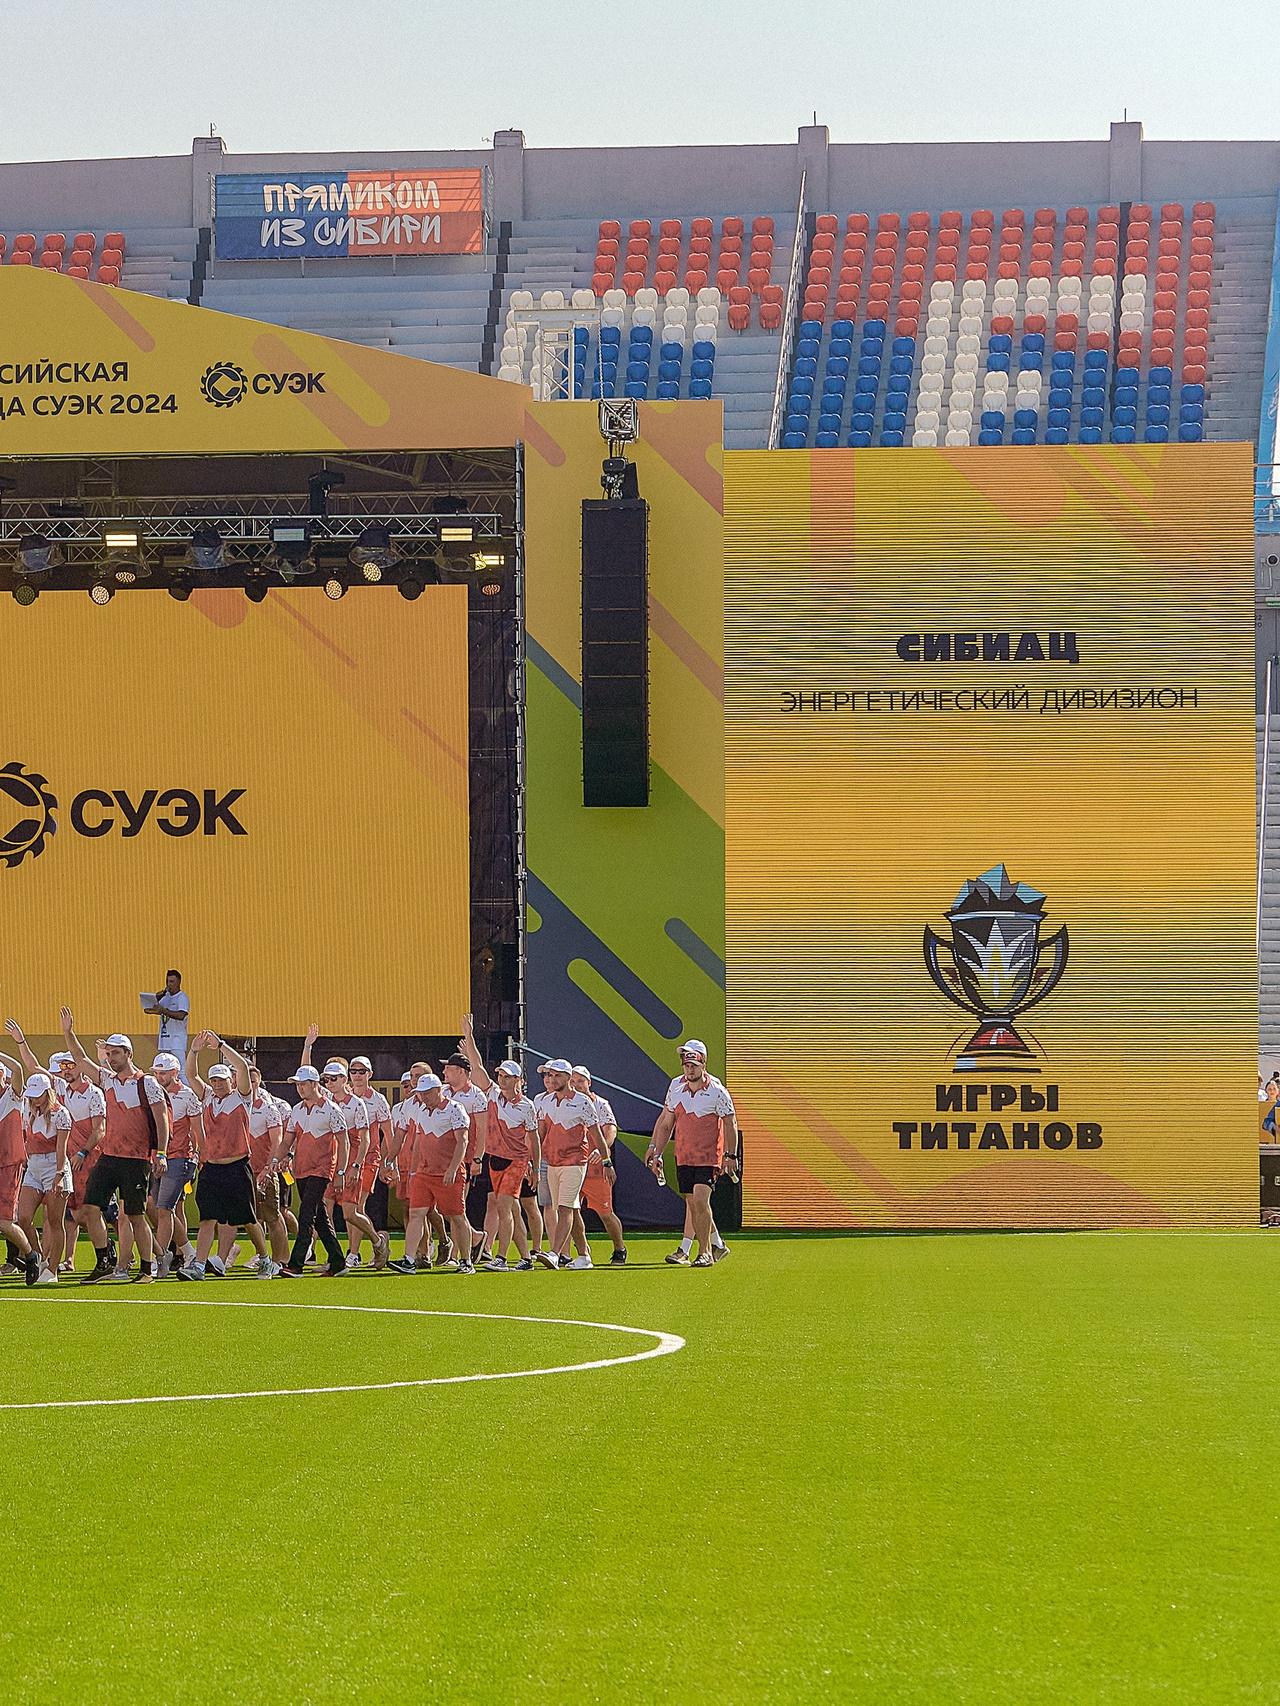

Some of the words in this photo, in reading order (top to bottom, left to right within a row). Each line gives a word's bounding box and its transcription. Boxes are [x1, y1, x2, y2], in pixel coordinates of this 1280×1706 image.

[262, 180, 441, 213] ПРЯМИКОМ
[260, 218, 306, 248] ИЗ
[313, 214, 441, 246] СИБИРИ
[252, 373, 326, 395] СУЭК
[32, 394, 103, 416] СУЭК
[110, 394, 178, 414] 2024
[896, 633, 1081, 663] СИБИАЦ
[780, 684, 1030, 712] ЭНЕРГЕТИЧЕСКИЙ
[1040, 688, 1199, 714] ДИВИЗИОН
[70, 788, 248, 838] СУЭК
[935, 1084, 1059, 1112] ИГРЫ
[892, 1121, 1103, 1151] ТИТАНОВ
